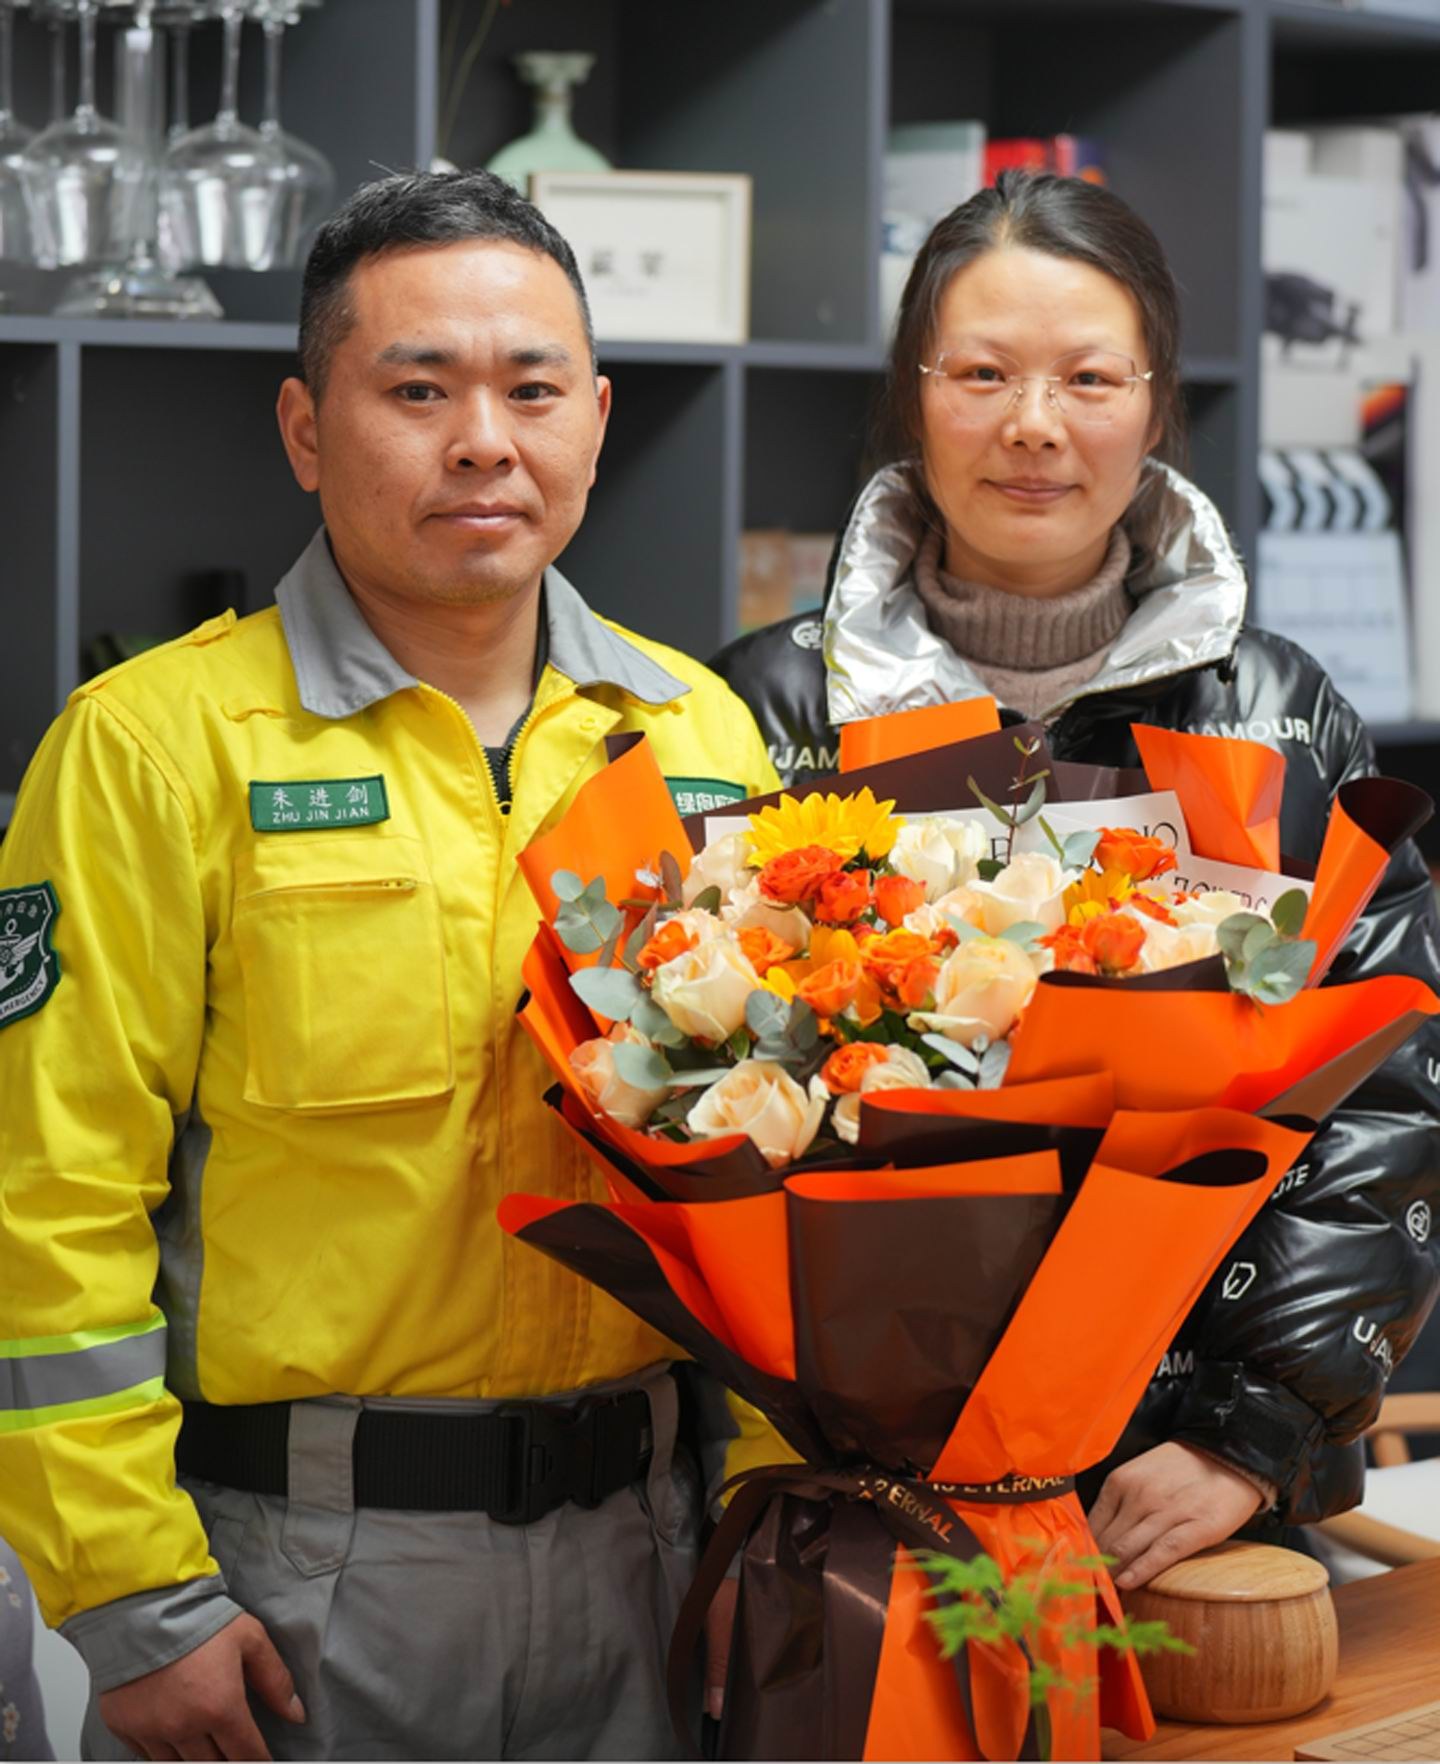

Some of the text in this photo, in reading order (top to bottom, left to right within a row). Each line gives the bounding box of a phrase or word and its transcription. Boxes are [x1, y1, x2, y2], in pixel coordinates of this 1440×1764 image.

[272, 806, 369, 824] ZHU JIN JIAN
